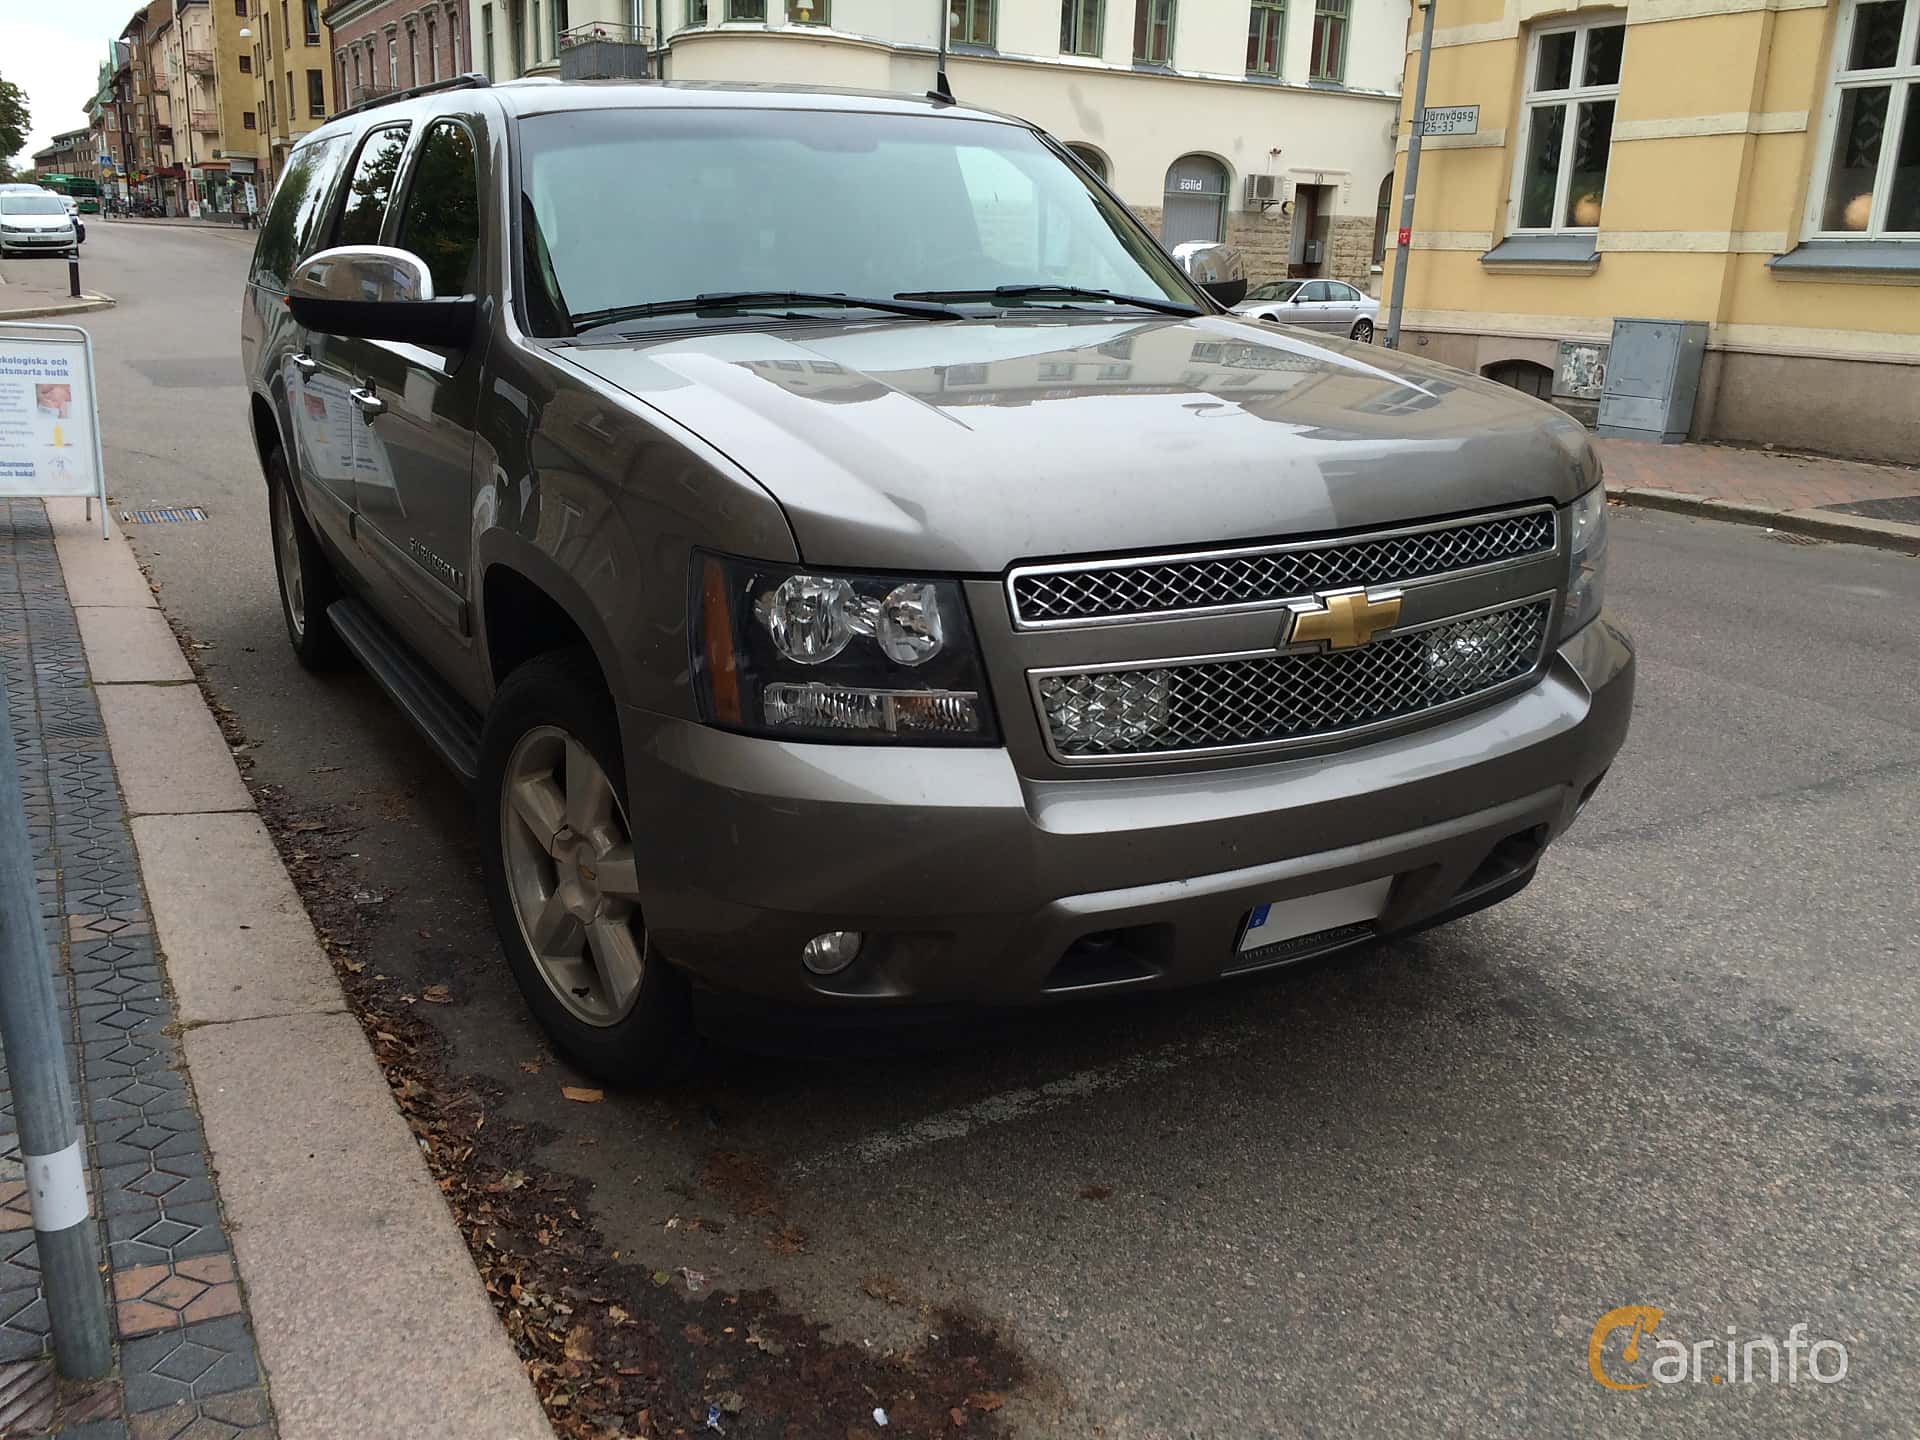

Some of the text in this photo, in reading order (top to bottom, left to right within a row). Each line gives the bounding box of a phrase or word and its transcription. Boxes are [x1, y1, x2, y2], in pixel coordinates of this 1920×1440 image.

[1425, 121, 1454, 132] 25-33
[1180, 179, 1202, 190] solid
[45, 368, 69, 376] butik
